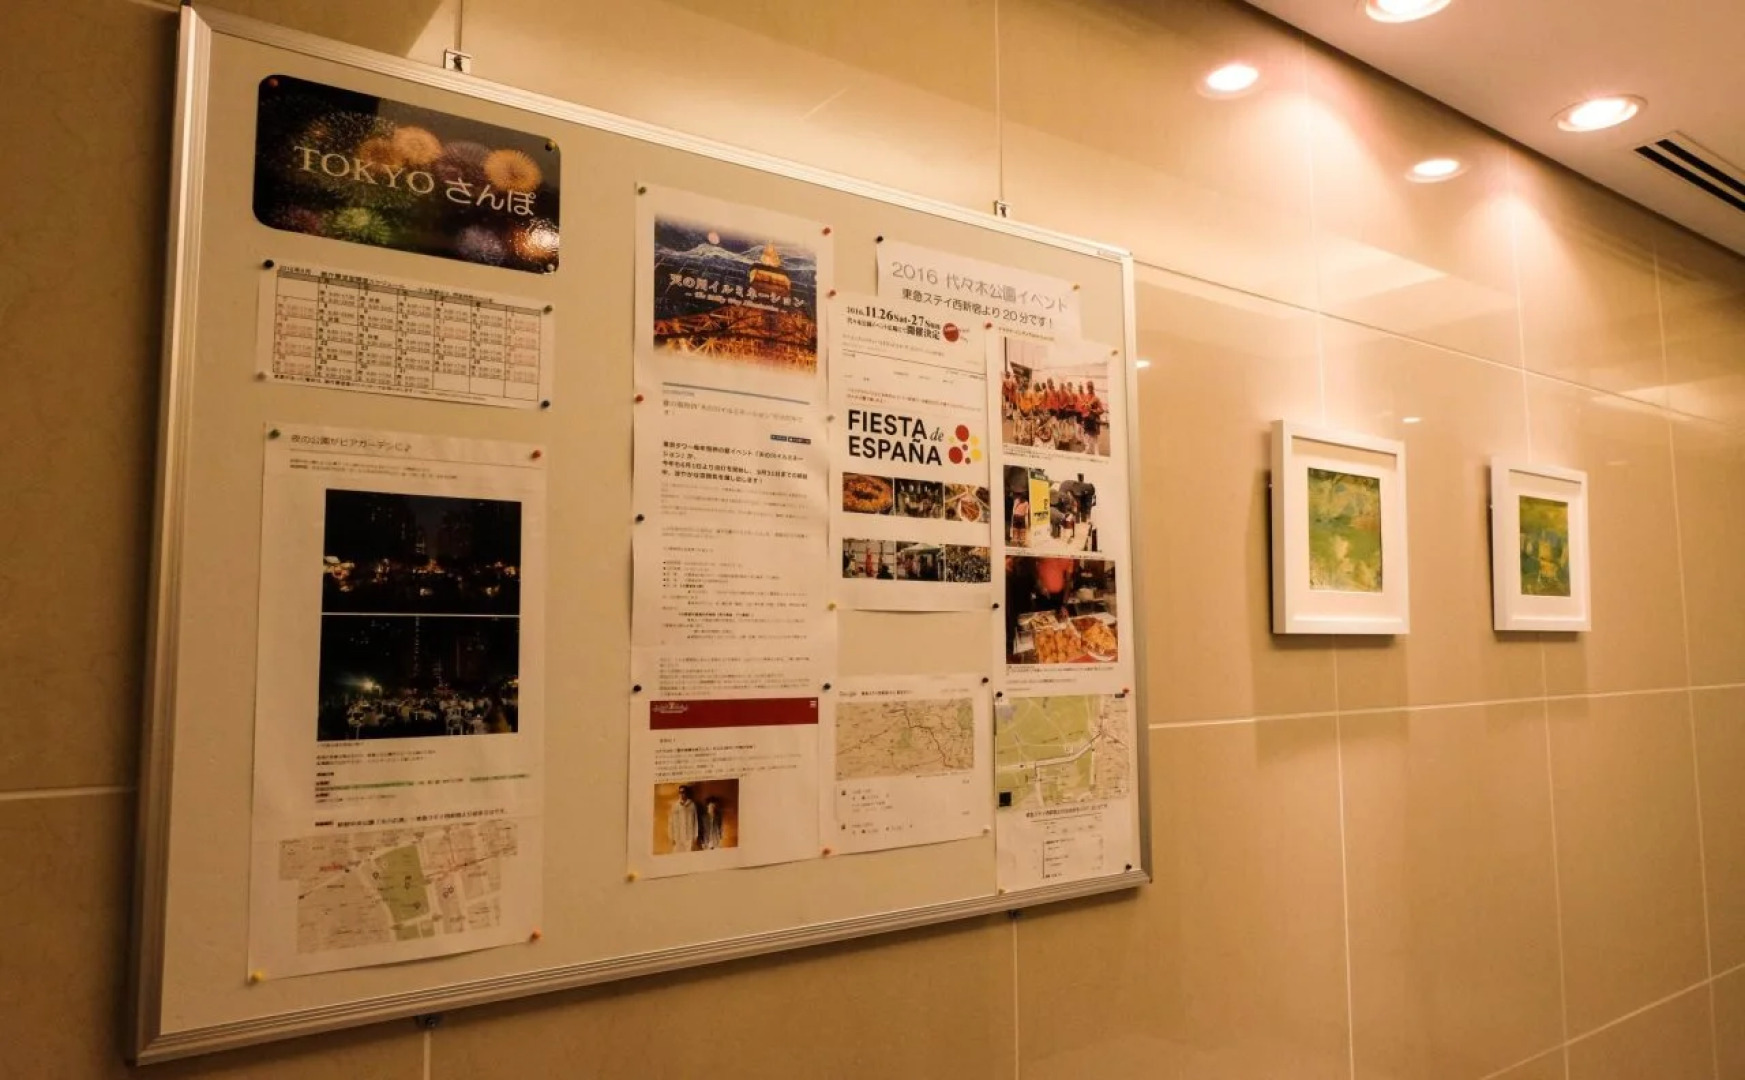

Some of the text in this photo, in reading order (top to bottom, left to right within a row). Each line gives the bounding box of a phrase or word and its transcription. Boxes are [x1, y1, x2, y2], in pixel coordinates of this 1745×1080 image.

[294, 146, 537, 216] TOKYO さんぽ
[892, 261, 1067, 312] 2016 代々木公園イベント
[848, 409, 944, 442] FIESTA de
[848, 434, 942, 466] ESPAÑA
